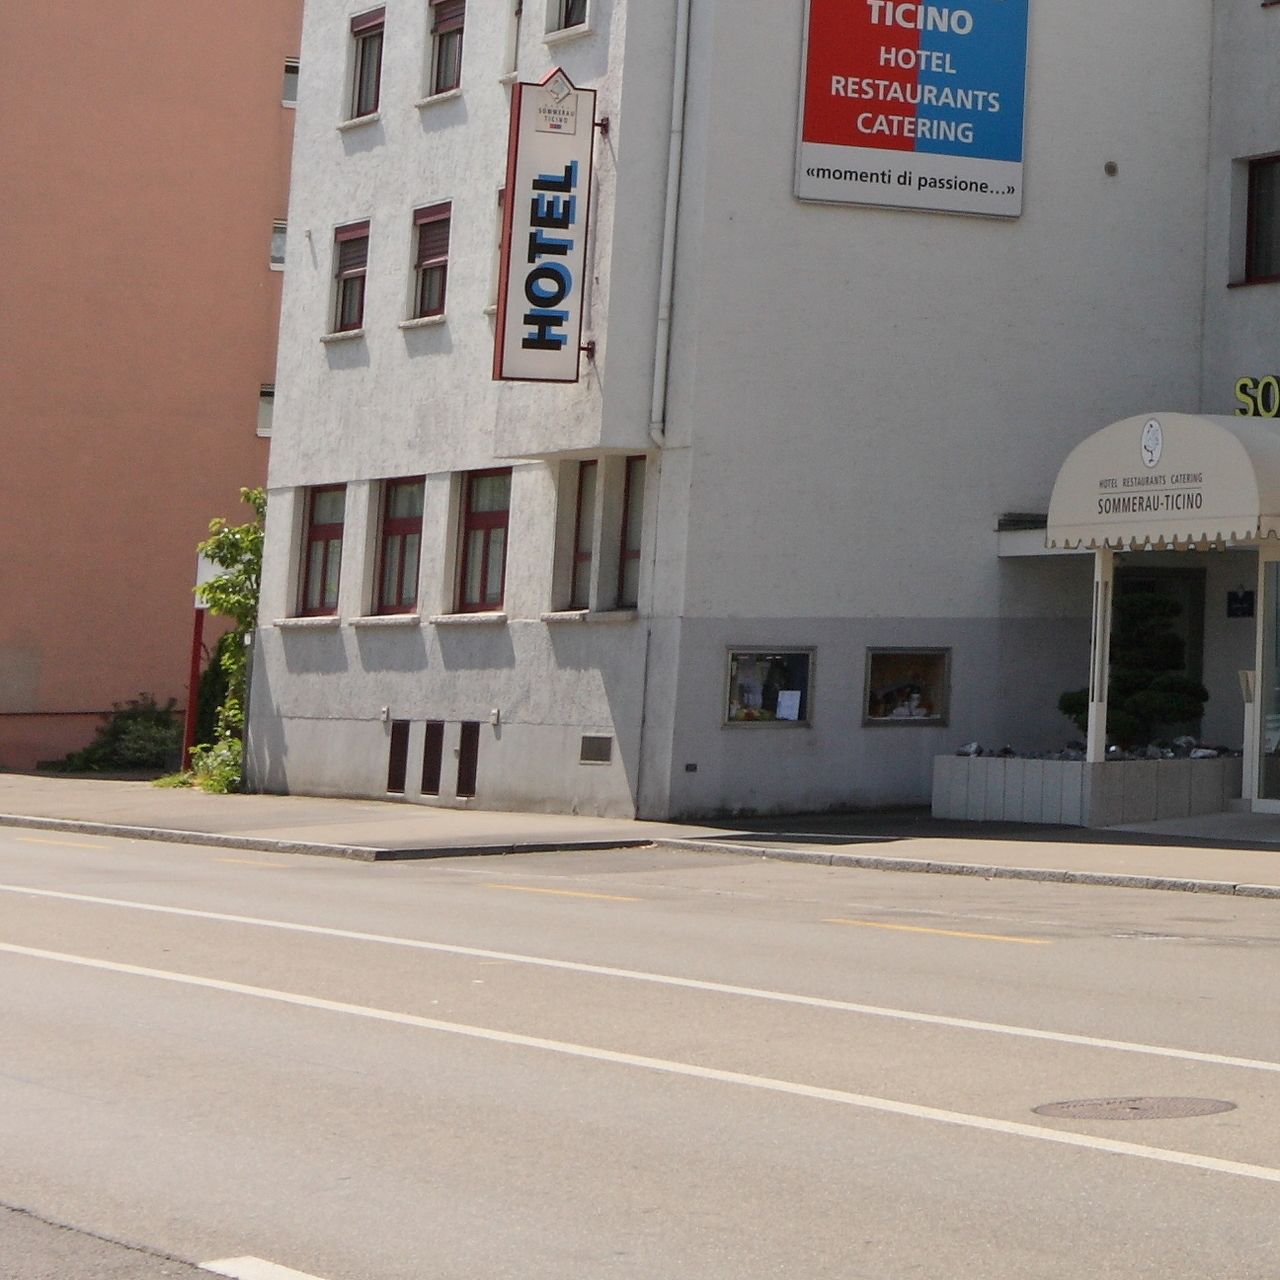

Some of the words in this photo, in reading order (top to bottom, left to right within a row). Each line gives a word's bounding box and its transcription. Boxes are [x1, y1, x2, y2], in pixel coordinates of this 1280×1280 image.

[866, 0, 974, 35] TICINO
[879, 46, 957, 76] HOTEL
[831, 75, 1000, 113] RESTAURANTS
[856, 112, 974, 144] CATERING
[896, 170, 913, 188] di
[521, 160, 579, 351] HOTEL
[1099, 478, 1118, 489] HOTEL
[1122, 474, 1166, 487] RESTAURANTS
[1170, 472, 1203, 484] CATERING
[1097, 492, 1203, 515] SOMMERAU-TICINO
